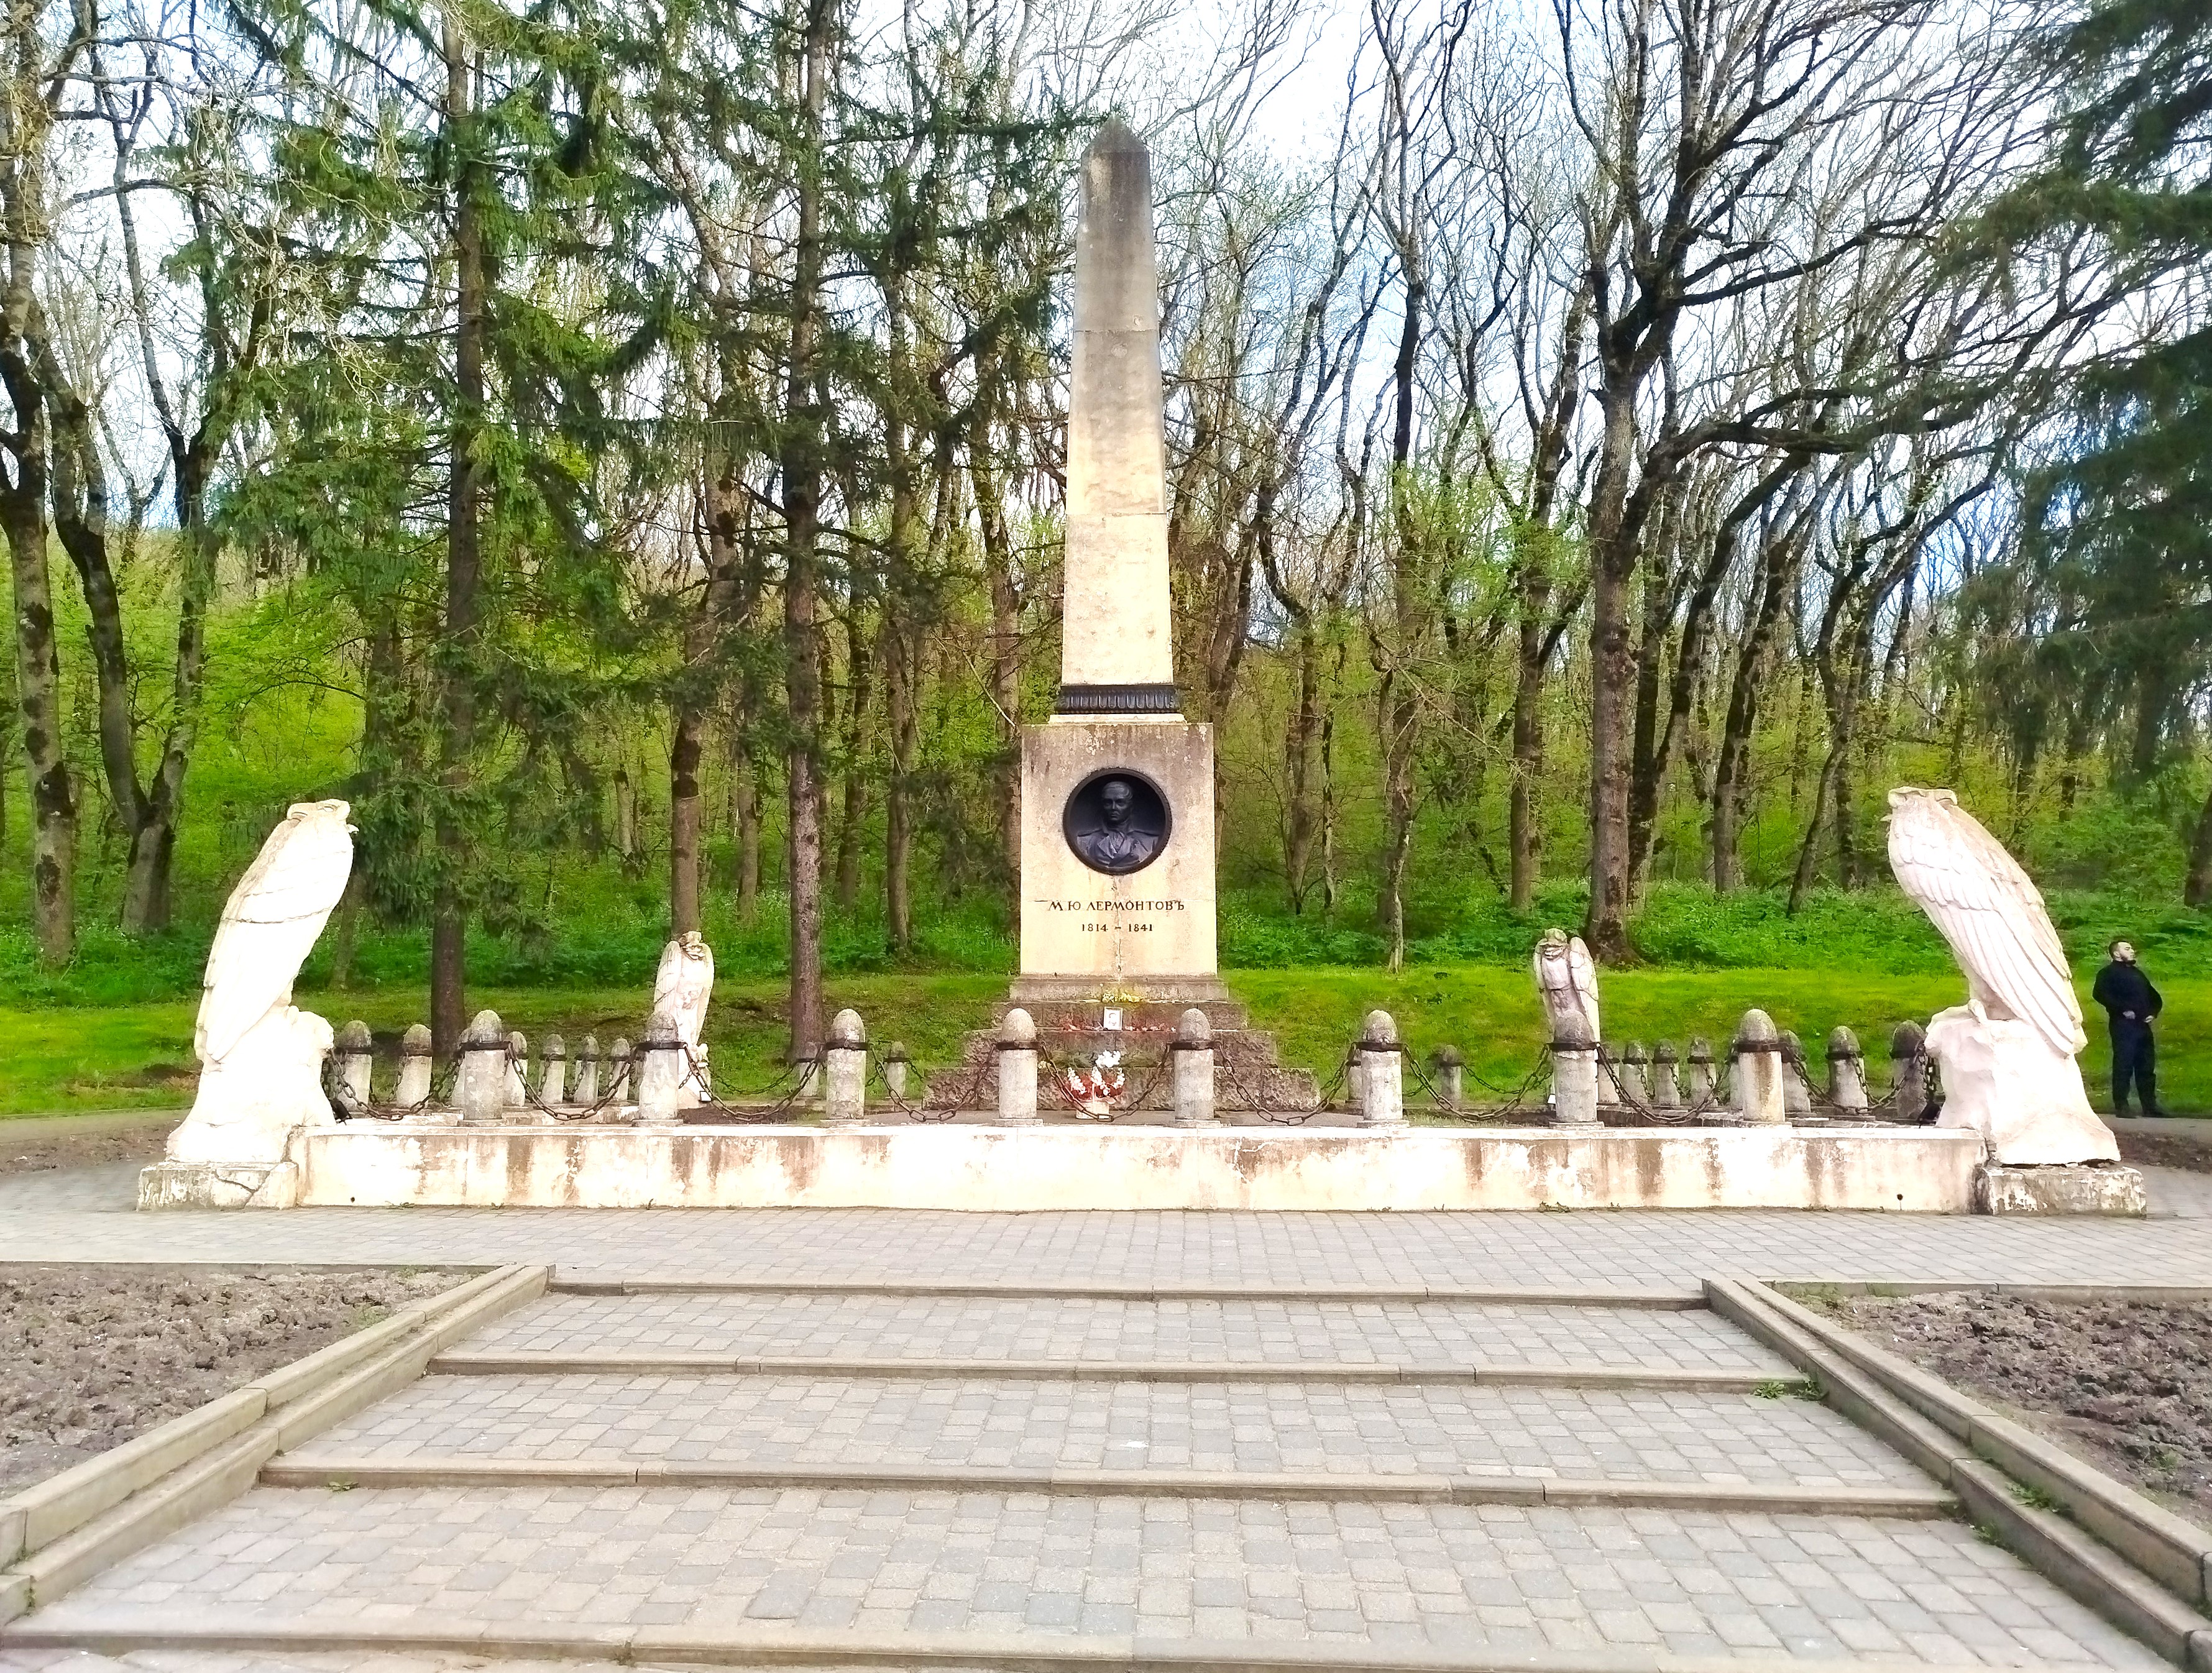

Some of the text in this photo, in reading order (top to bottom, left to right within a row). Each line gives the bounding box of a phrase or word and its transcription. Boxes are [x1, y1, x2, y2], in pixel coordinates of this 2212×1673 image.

[1086, 900, 1185, 911] ЛЕРМОНТОВЪ
[1081, 924, 1108, 932] 1814
[1129, 924, 1152, 932] 1841
